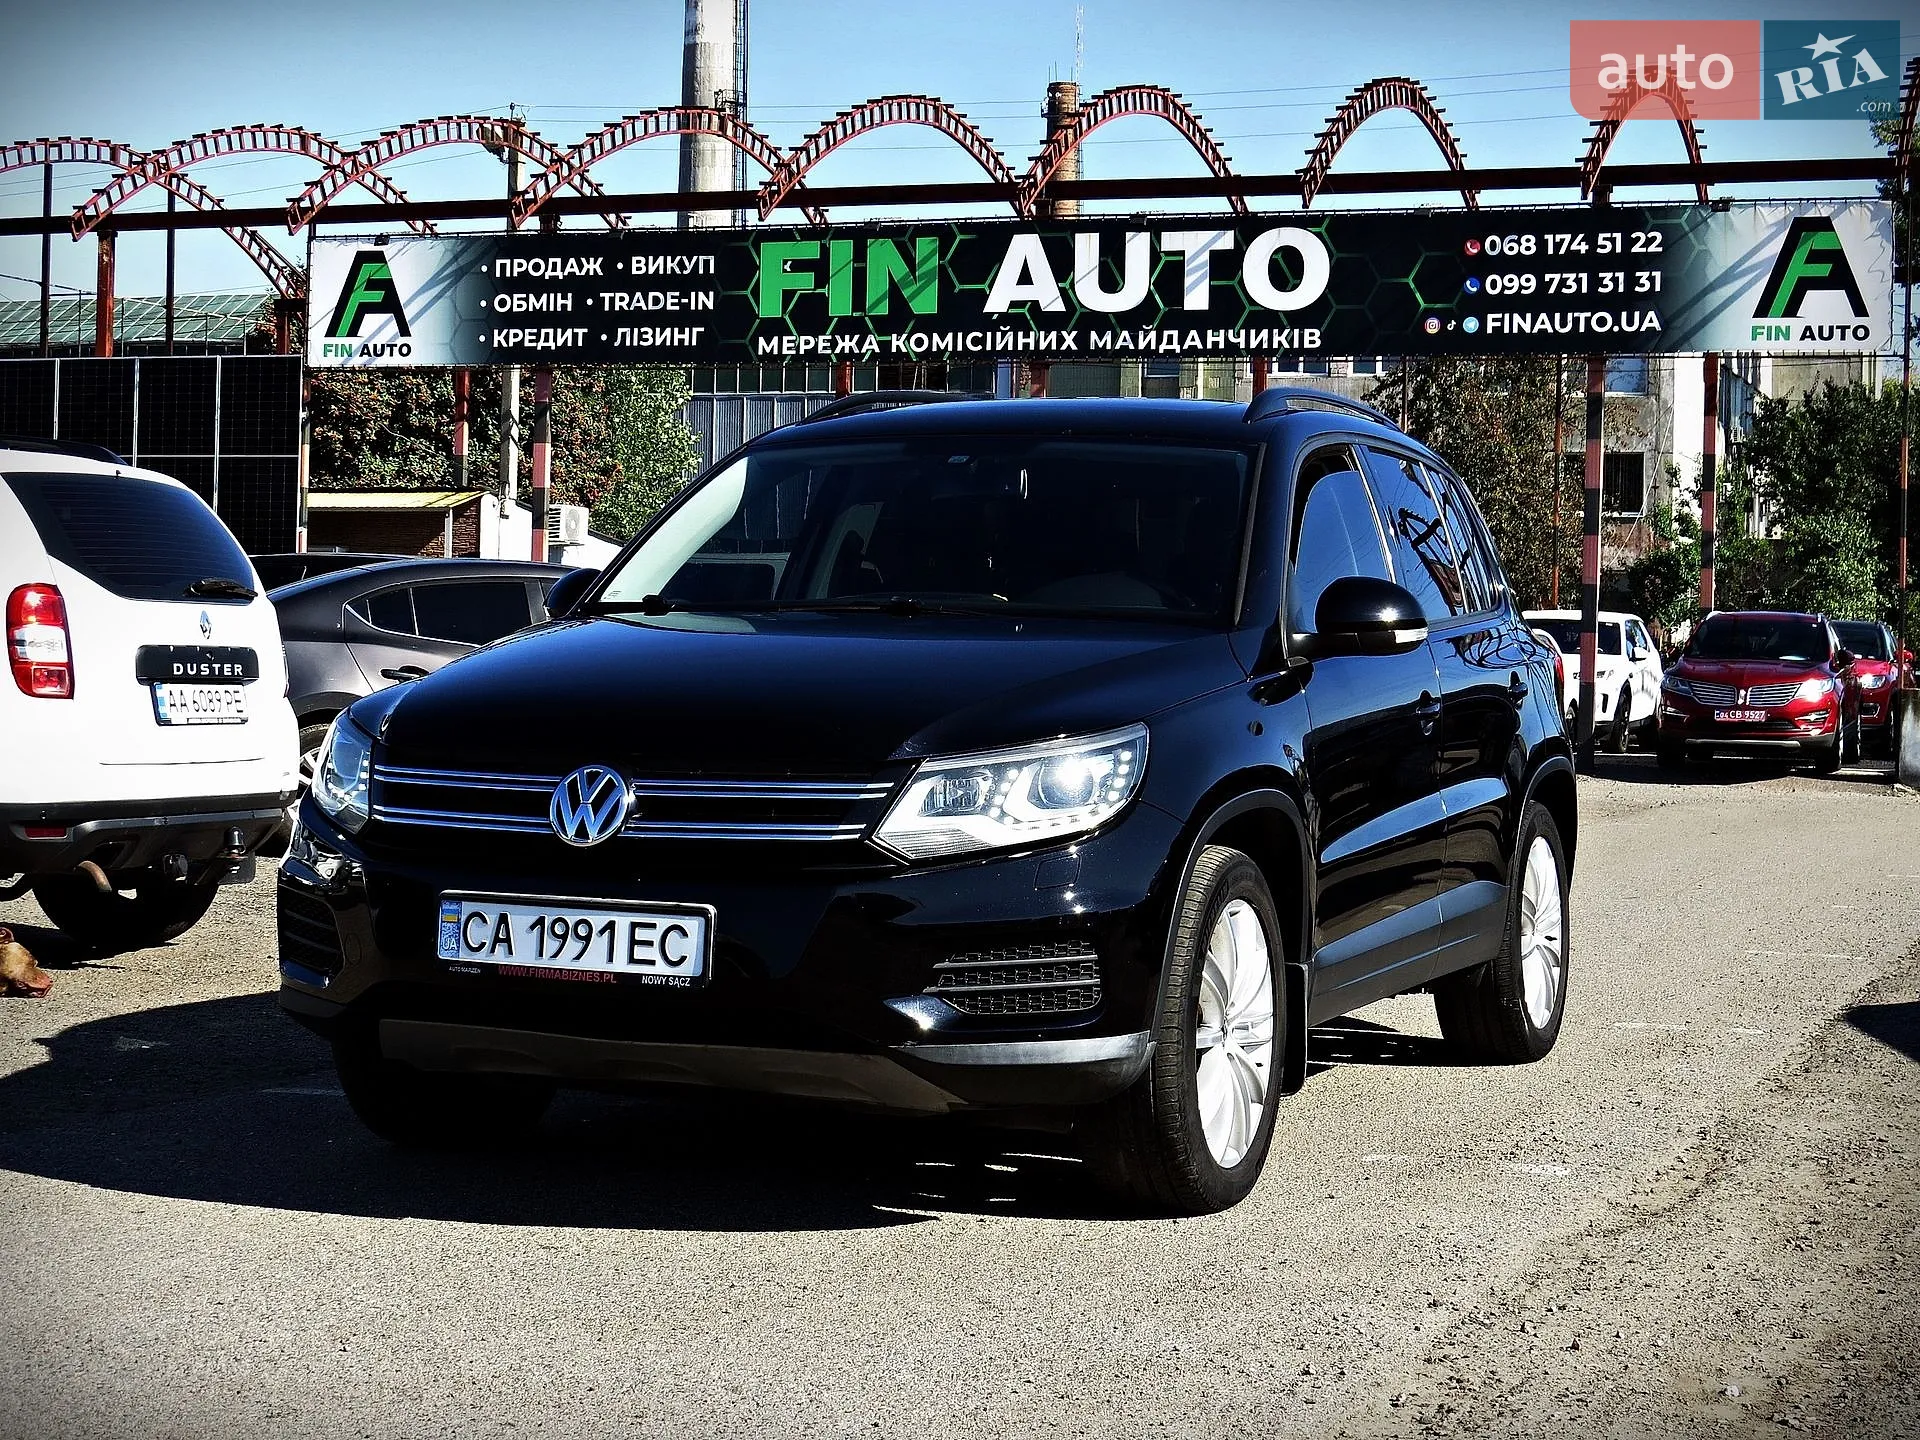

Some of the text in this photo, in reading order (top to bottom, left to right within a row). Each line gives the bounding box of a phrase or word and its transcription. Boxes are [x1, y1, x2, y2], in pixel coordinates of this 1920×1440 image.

[1485, 232, 1663, 256] 068 174 51 22
[496, 256, 715, 280] ПРОДАЖ ВИКУП
[759, 227, 1330, 318] FIN AUTO
[1486, 271, 1662, 295] 099 731 31 31
[494, 293, 573, 312] ОБМІН
[600, 291, 714, 312] TRADE-IN
[1486, 311, 1662, 334] FINAUTO.UA
[1751, 324, 1871, 342] FIN AUTO
[494, 327, 705, 350] КРЕДИТ ЛІЗИНГ
[758, 324, 1322, 355] МЕРЕЖА КОМІСІЙНИХ МАЙДАНЧИКІВ
[323, 343, 412, 358] FIN AUTO
[173, 663, 243, 676] DUSTER
[169, 690, 244, 714] AA 6089 PE
[462, 911, 690, 968] CA 1991 EC
[498, 965, 617, 984] WWW.FIRMABIZNES.PL
[641, 975, 691, 989] NOWY SĄCZ
